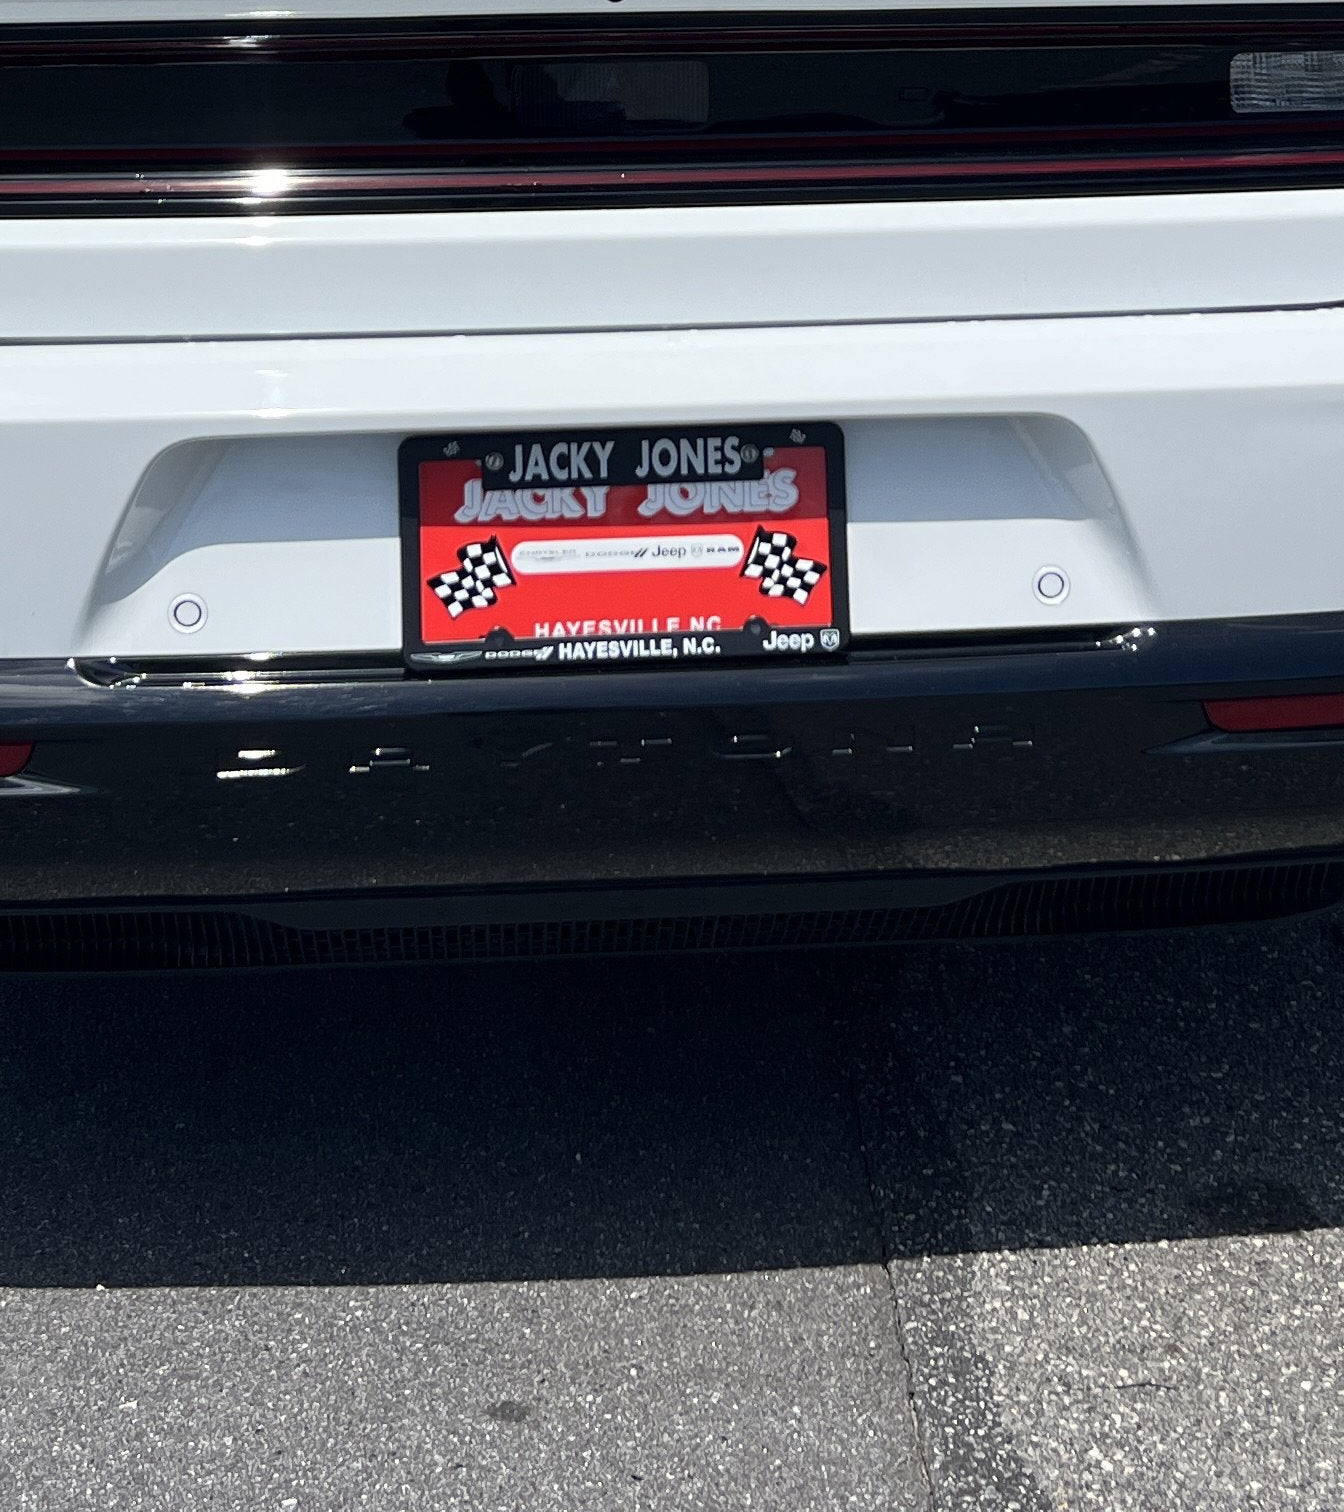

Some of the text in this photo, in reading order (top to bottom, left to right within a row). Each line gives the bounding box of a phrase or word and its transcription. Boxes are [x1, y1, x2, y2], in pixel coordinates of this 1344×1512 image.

[509, 436, 742, 483] JACKY JONES
[454, 468, 800, 524] JACKY JONES
[652, 547, 687, 559] Jeep
[558, 637, 678, 661] HAYESVILLE,
[683, 637, 721, 653] N.C.
[762, 629, 815, 653] Jeep
